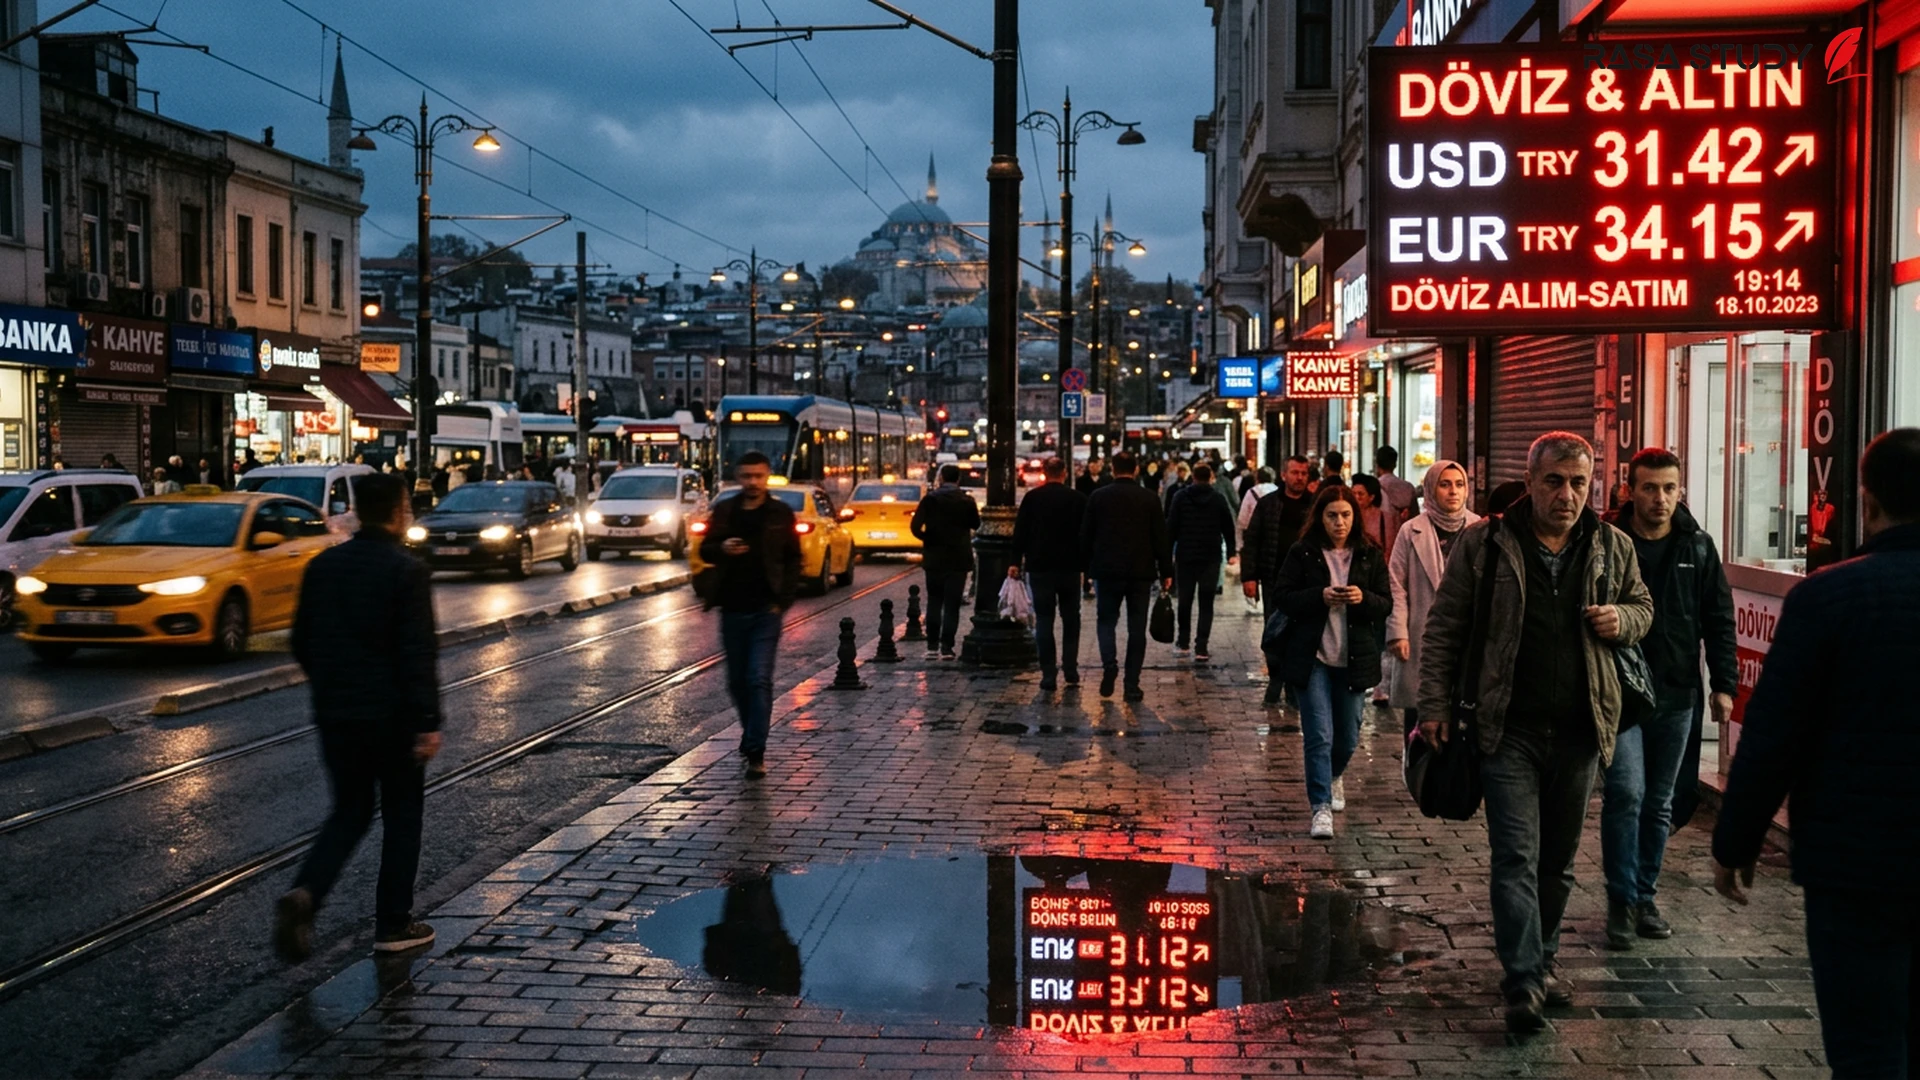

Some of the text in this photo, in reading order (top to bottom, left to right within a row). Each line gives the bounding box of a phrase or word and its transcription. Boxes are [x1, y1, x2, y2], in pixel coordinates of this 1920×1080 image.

[1400, 58, 1802, 117] DÖVİZ & ALTIN
[1389, 127, 1763, 189] USD TRY 31.42
[1389, 203, 1763, 263] EUR TRY 34.15
[1391, 276, 1490, 312] DÖVİZ
[1497, 279, 1688, 310] ALIM-SATIM
[1734, 269, 1801, 292] 19:14
[1715, 295, 1819, 315] 18.10.2023
[103, 325, 164, 356] KAHVE
[1293, 358, 1351, 374] KANVE
[1293, 376, 1351, 392] KANVE
[1738, 602, 1776, 644] DÖVİZ
